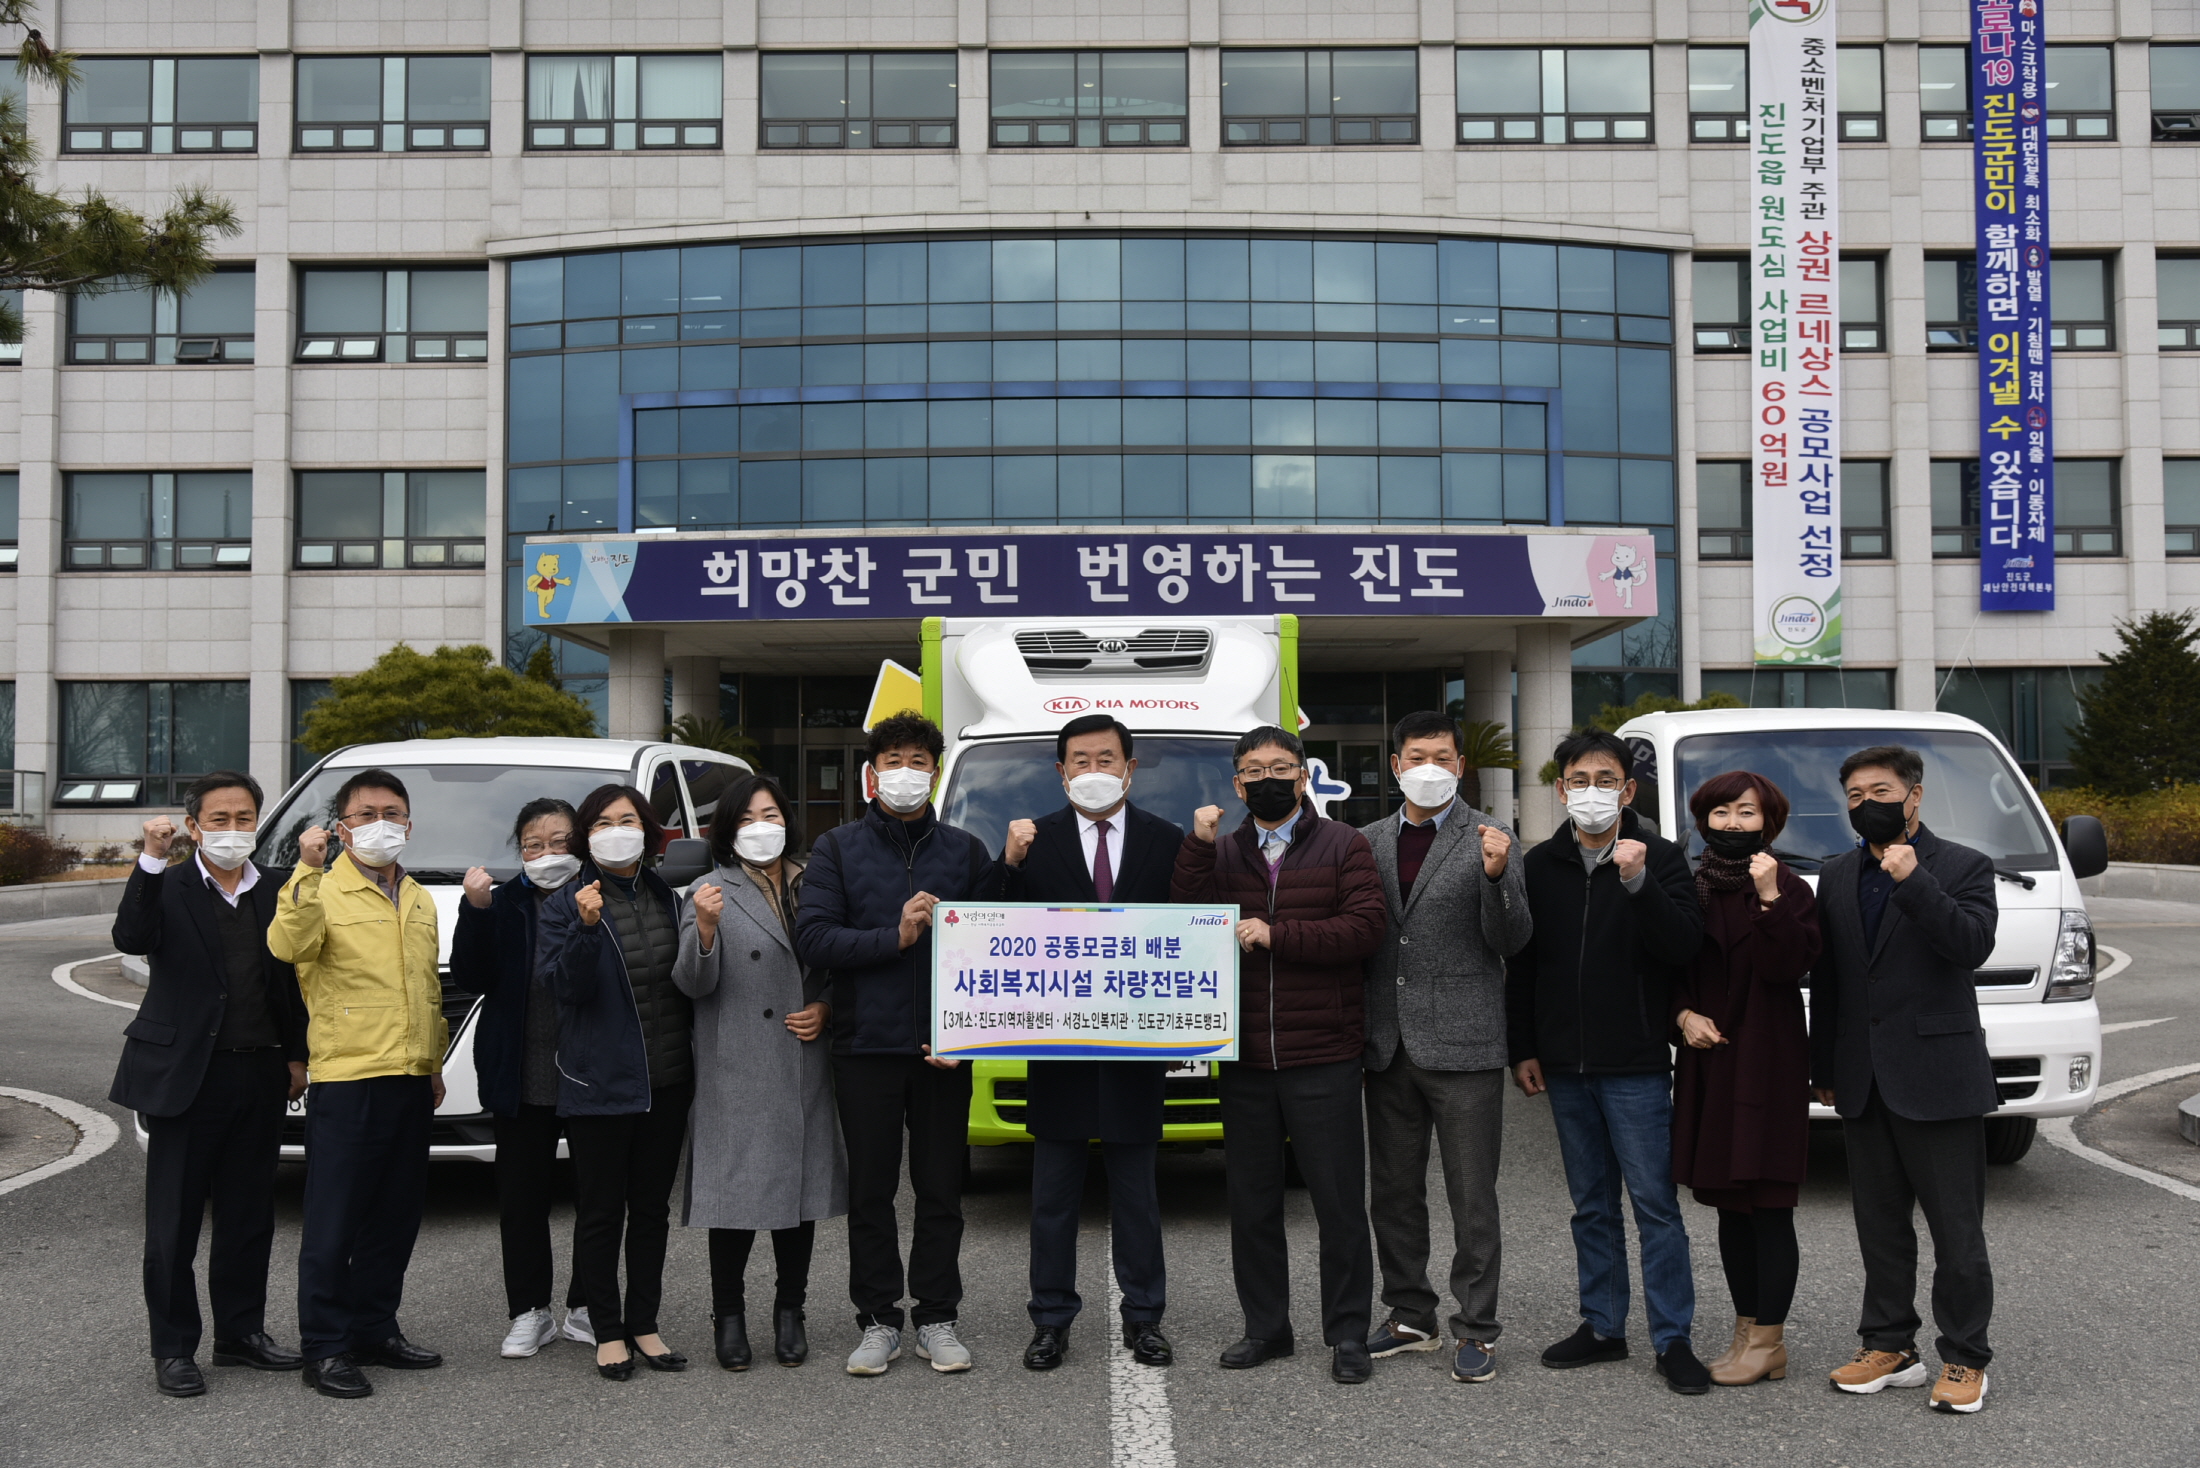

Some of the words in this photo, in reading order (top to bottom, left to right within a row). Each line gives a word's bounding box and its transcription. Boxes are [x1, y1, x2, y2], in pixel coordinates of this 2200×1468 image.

[2021, 20, 2038, 99] 마스크착용
[1800, 38, 1827, 174] 중소벤처기업부
[1757, 103, 1786, 185] 진도읍
[1982, 93, 2017, 214] 진도군민이
[2022, 126, 2040, 188] 대면접촉
[1800, 182, 1827, 220] 주관
[2024, 194, 2041, 242] 최소화
[1757, 195, 1787, 278] 원도심
[1796, 231, 1833, 282] 상권
[1985, 224, 2021, 321] 함께하면
[2027, 270, 2042, 302] 발열
[1758, 289, 1789, 372] 사업비
[1796, 293, 1833, 396] 르네상스
[2027, 317, 2043, 365] 기침땐
[1988, 331, 2021, 405] 이겨낼
[2028, 371, 2045, 403] 검사
[1759, 381, 1788, 487] 60억원
[1988, 415, 2022, 440] 수
[2028, 431, 2045, 463] 외출
[1798, 408, 1833, 515] 공모사업
[1988, 450, 2022, 549] 있습니다
[2027, 478, 2046, 543] 이동자제
[610, 553, 632, 567] 진도
[701, 547, 877, 608] 희망찬
[902, 544, 1019, 605] 군민
[1077, 542, 1322, 604] 번영하는
[1349, 543, 1464, 603] 진도
[1798, 525, 1833, 578] 선정
[2006, 571, 2031, 582] 진도군
[1551, 597, 1587, 608] Jindo
[1777, 613, 1810, 624] Jindo
[1102, 641, 1124, 651] KIA
[1052, 700, 1083, 710] KIA
[1095, 699, 1124, 708] KIA
[1129, 699, 1200, 711] MOTORS
[1187, 914, 1222, 926] Jindo
[989, 936, 1037, 957] 2020
[1044, 936, 1136, 959] 공동모금회
[1145, 936, 1182, 959] 배분
[954, 968, 1093, 998] 사회복지시설
[1103, 969, 1218, 998] 차량전달식
[1062, 1011, 1129, 1031] 서경노인복지관
